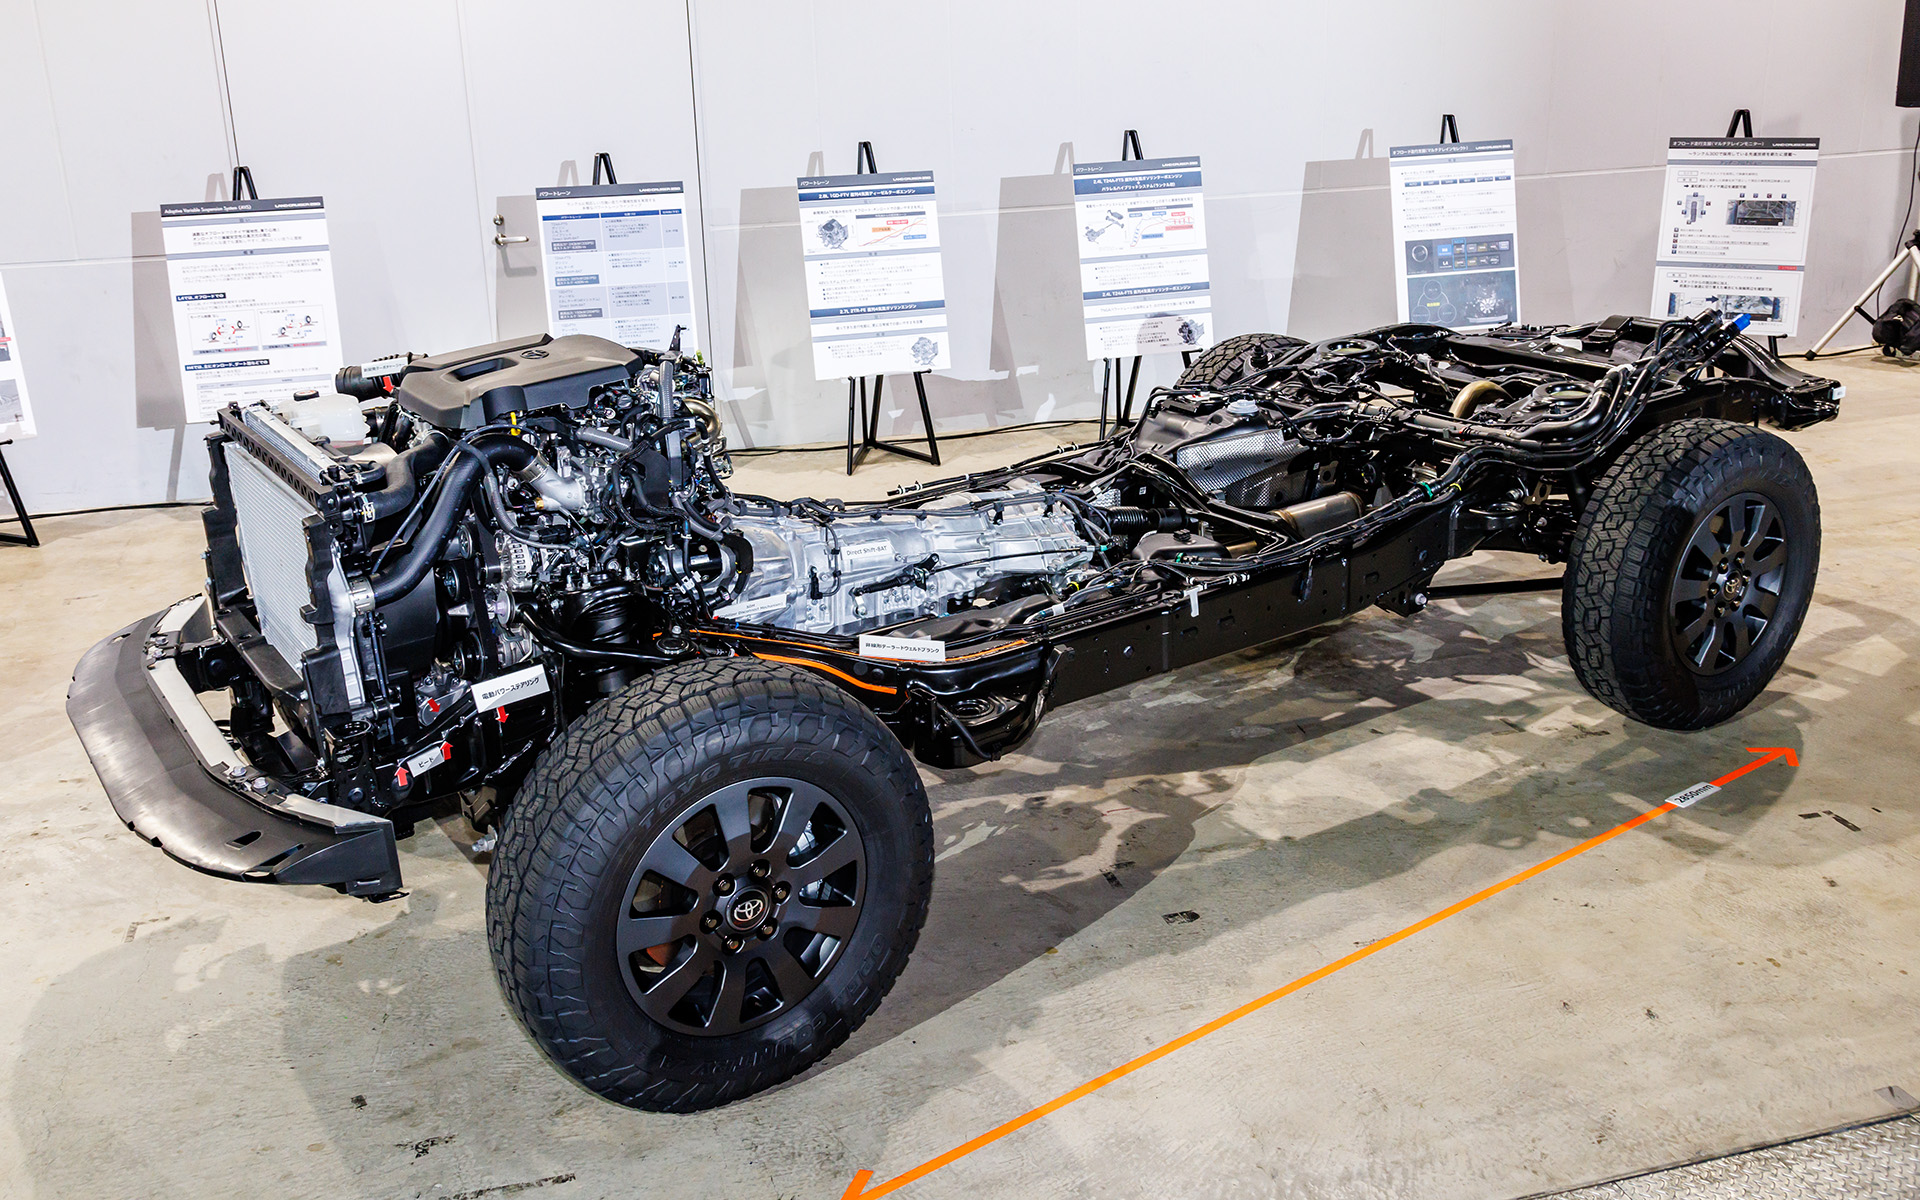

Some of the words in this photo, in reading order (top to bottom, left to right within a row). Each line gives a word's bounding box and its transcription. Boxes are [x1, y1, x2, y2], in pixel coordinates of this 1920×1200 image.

[863, 546, 887, 554] Shift-8AT
[482, 677, 540, 700] 電動パワーステアリング
[638, 762, 720, 828] TOYO
[728, 746, 832, 770] TIRES
[1674, 785, 1714, 803] 2850mm
